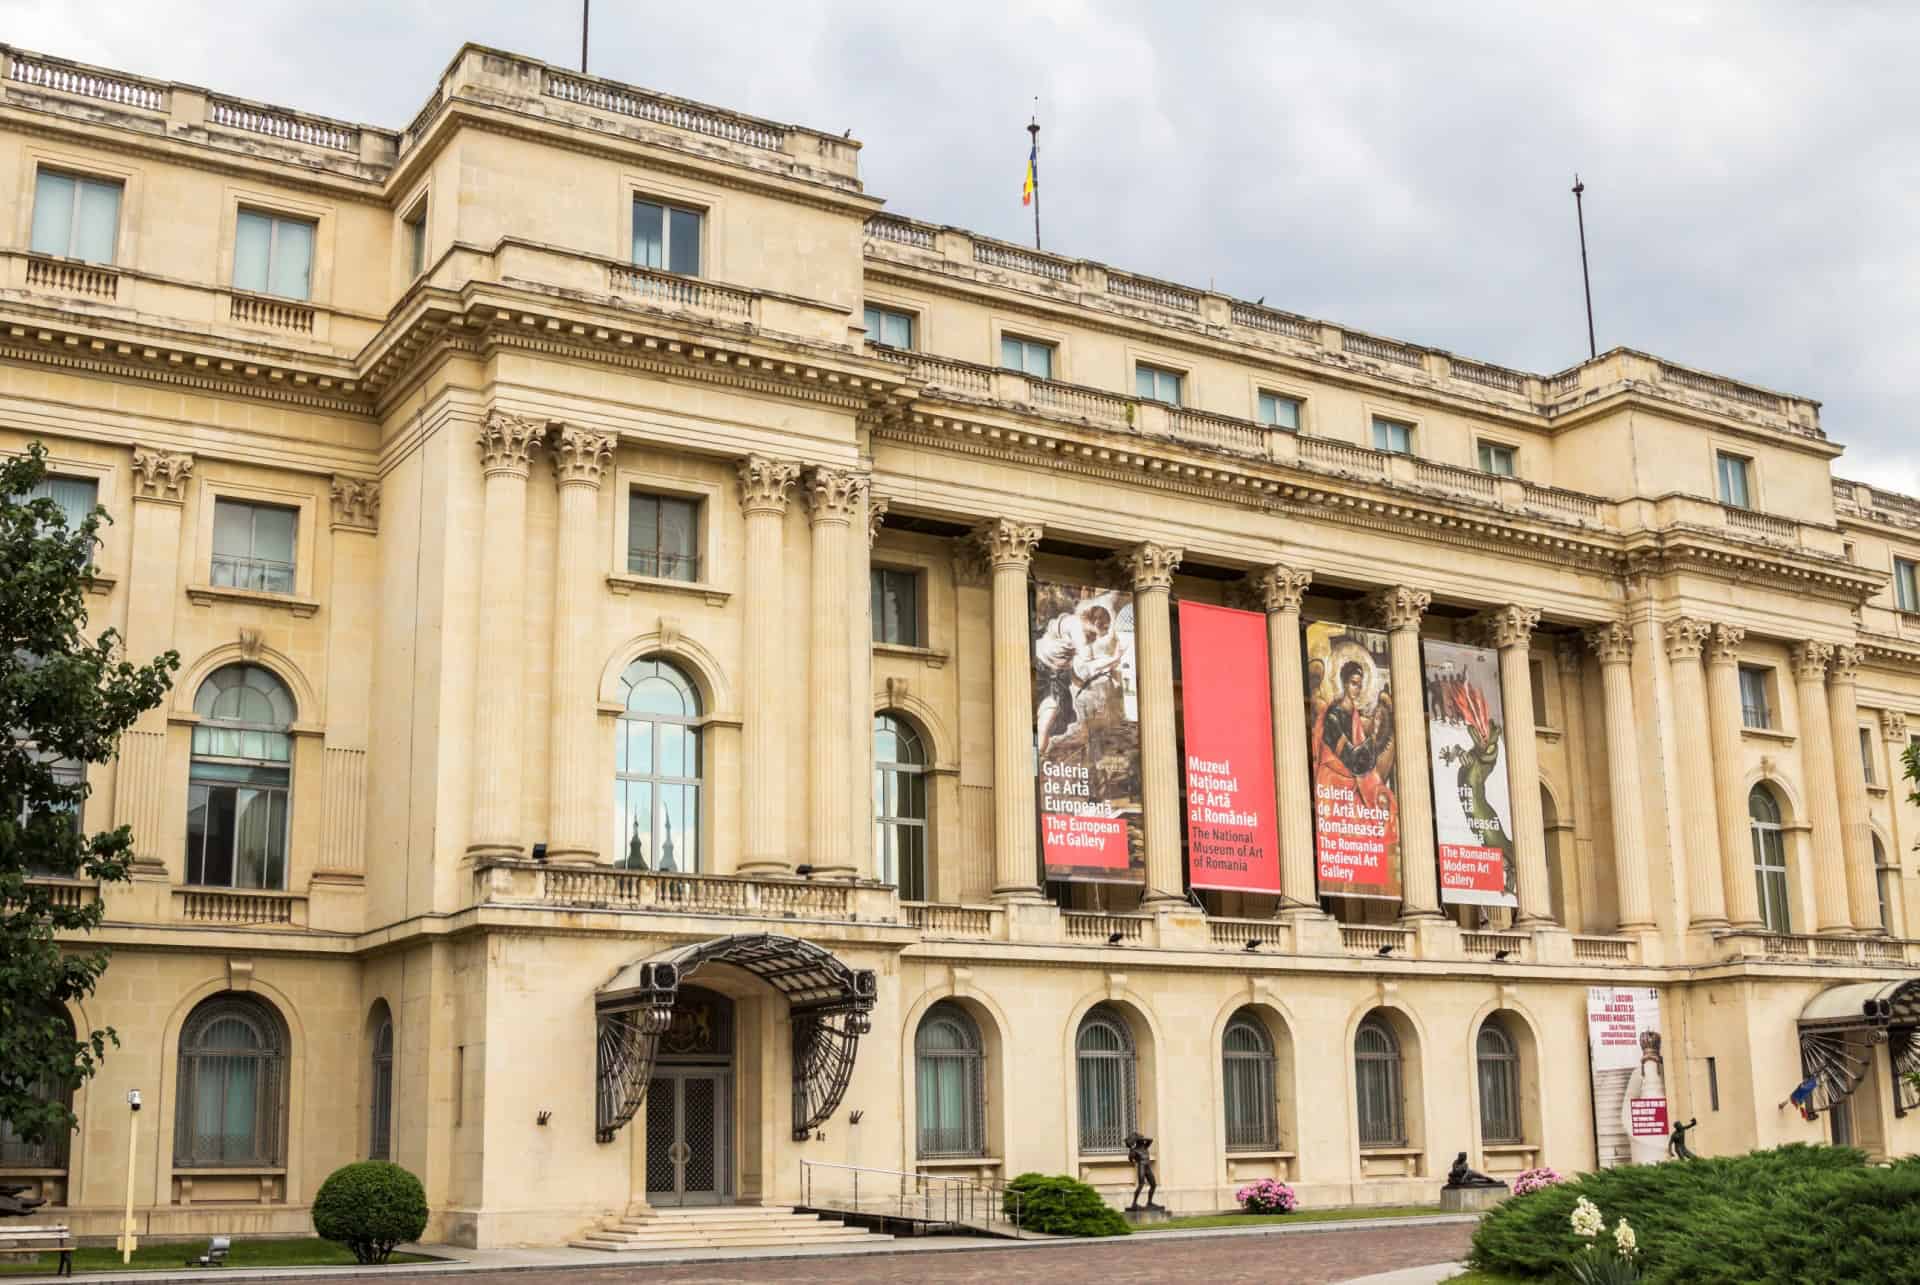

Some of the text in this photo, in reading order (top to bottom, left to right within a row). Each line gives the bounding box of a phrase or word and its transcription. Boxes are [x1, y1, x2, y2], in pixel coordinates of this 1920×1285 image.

[1043, 761, 1089, 779] Galeria
[1189, 756, 1230, 775] Muzeul
[1044, 779, 1089, 796] de Artă
[1317, 784, 1353, 801] Galeria
[1045, 796, 1112, 816] Europeană
[1191, 791, 1231, 808] de Artă
[1191, 808, 1257, 827] al României
[1318, 801, 1389, 821] de Artă Veche
[1046, 816, 1120, 835] The European
[1047, 832, 1105, 852] Art Gallery
[1193, 827, 1254, 843] The National
[1194, 842, 1263, 858] Museum of Art
[1320, 836, 1384, 853] The Romanian
[1321, 851, 1378, 867] Medieval Art
[1442, 847, 1501, 861] The Romanian
[1194, 856, 1248, 871] of Romania
[1443, 860, 1489, 873] Modern Art
[1321, 864, 1354, 882] Gallery
[1444, 873, 1474, 888] Gallery
